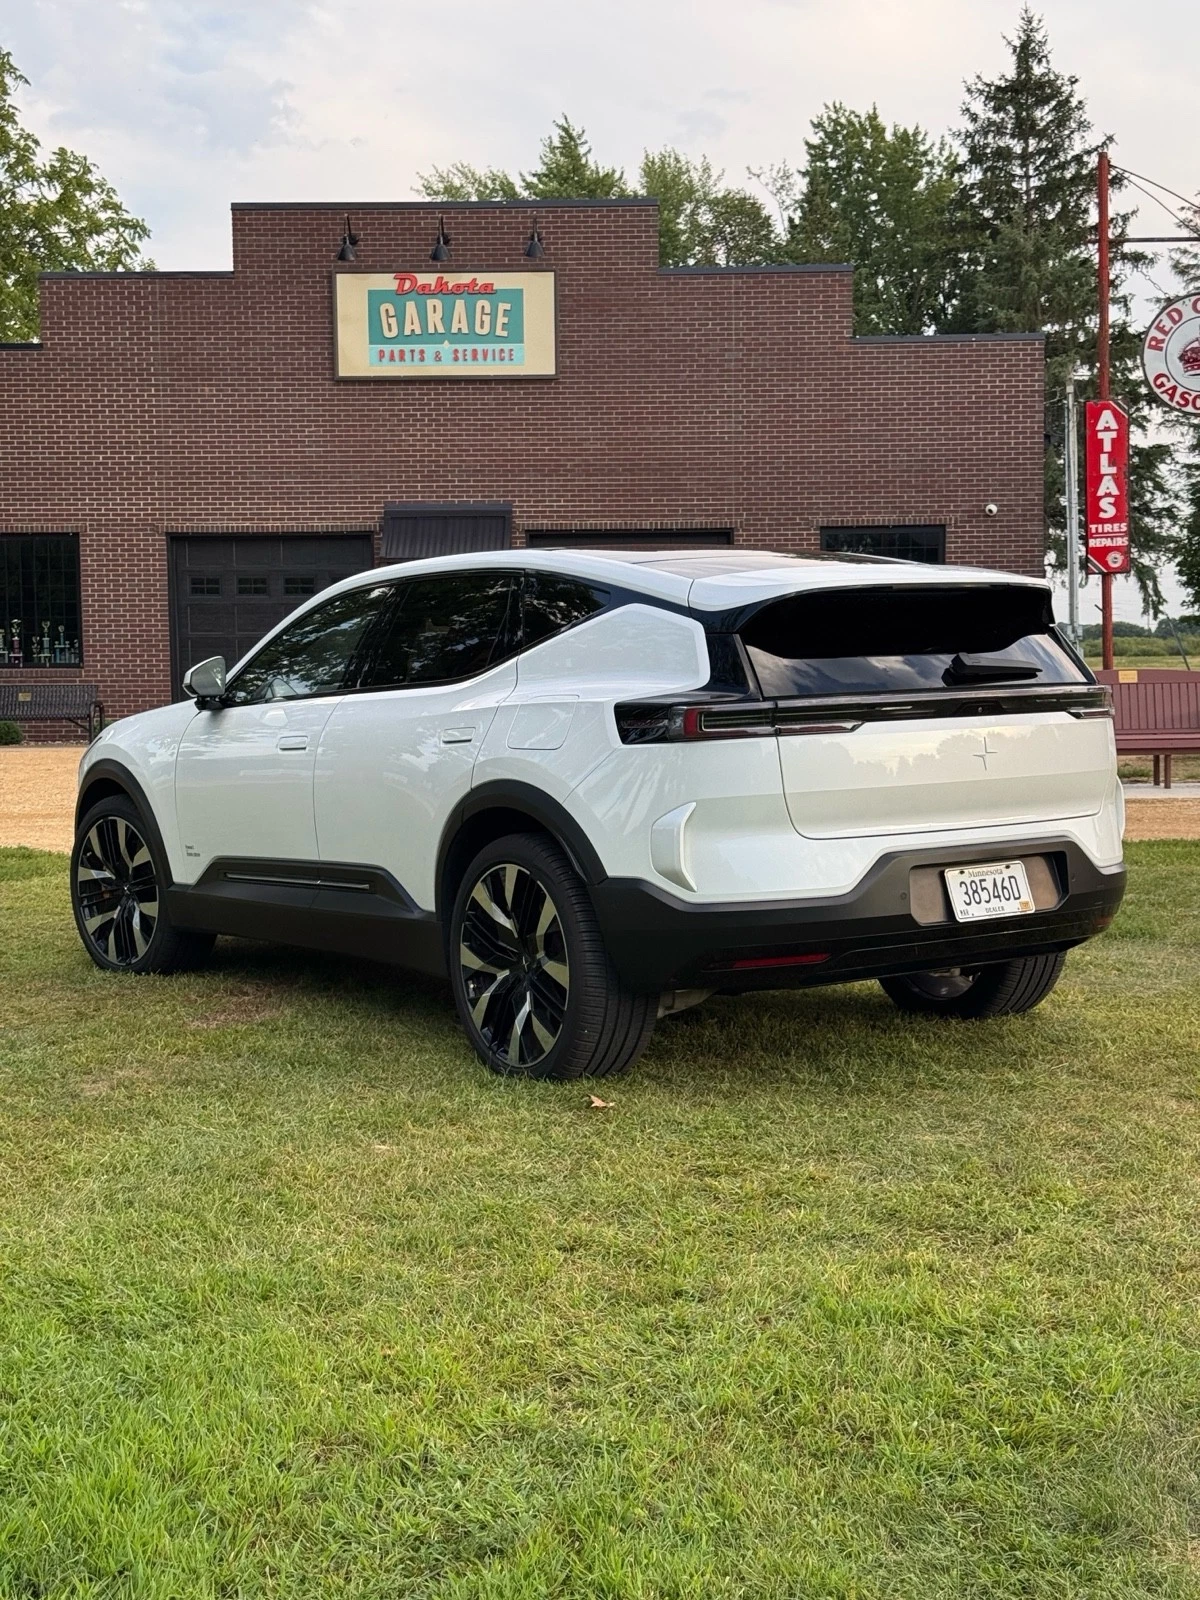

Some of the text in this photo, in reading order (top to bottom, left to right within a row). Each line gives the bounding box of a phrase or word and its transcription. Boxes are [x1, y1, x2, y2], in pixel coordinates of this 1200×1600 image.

[393, 272, 496, 295] Dakota
[379, 299, 512, 339] GARAGE
[1147, 307, 1183, 352] RED
[378, 348, 515, 362] PARTS & SERVICE
[1095, 409, 1120, 518] ATLAS
[1089, 522, 1128, 533] TIRES
[1089, 537, 1129, 547] REPAIRS
[968, 868, 1003, 878] Minnesota
[960, 875, 1021, 906] 38546D
